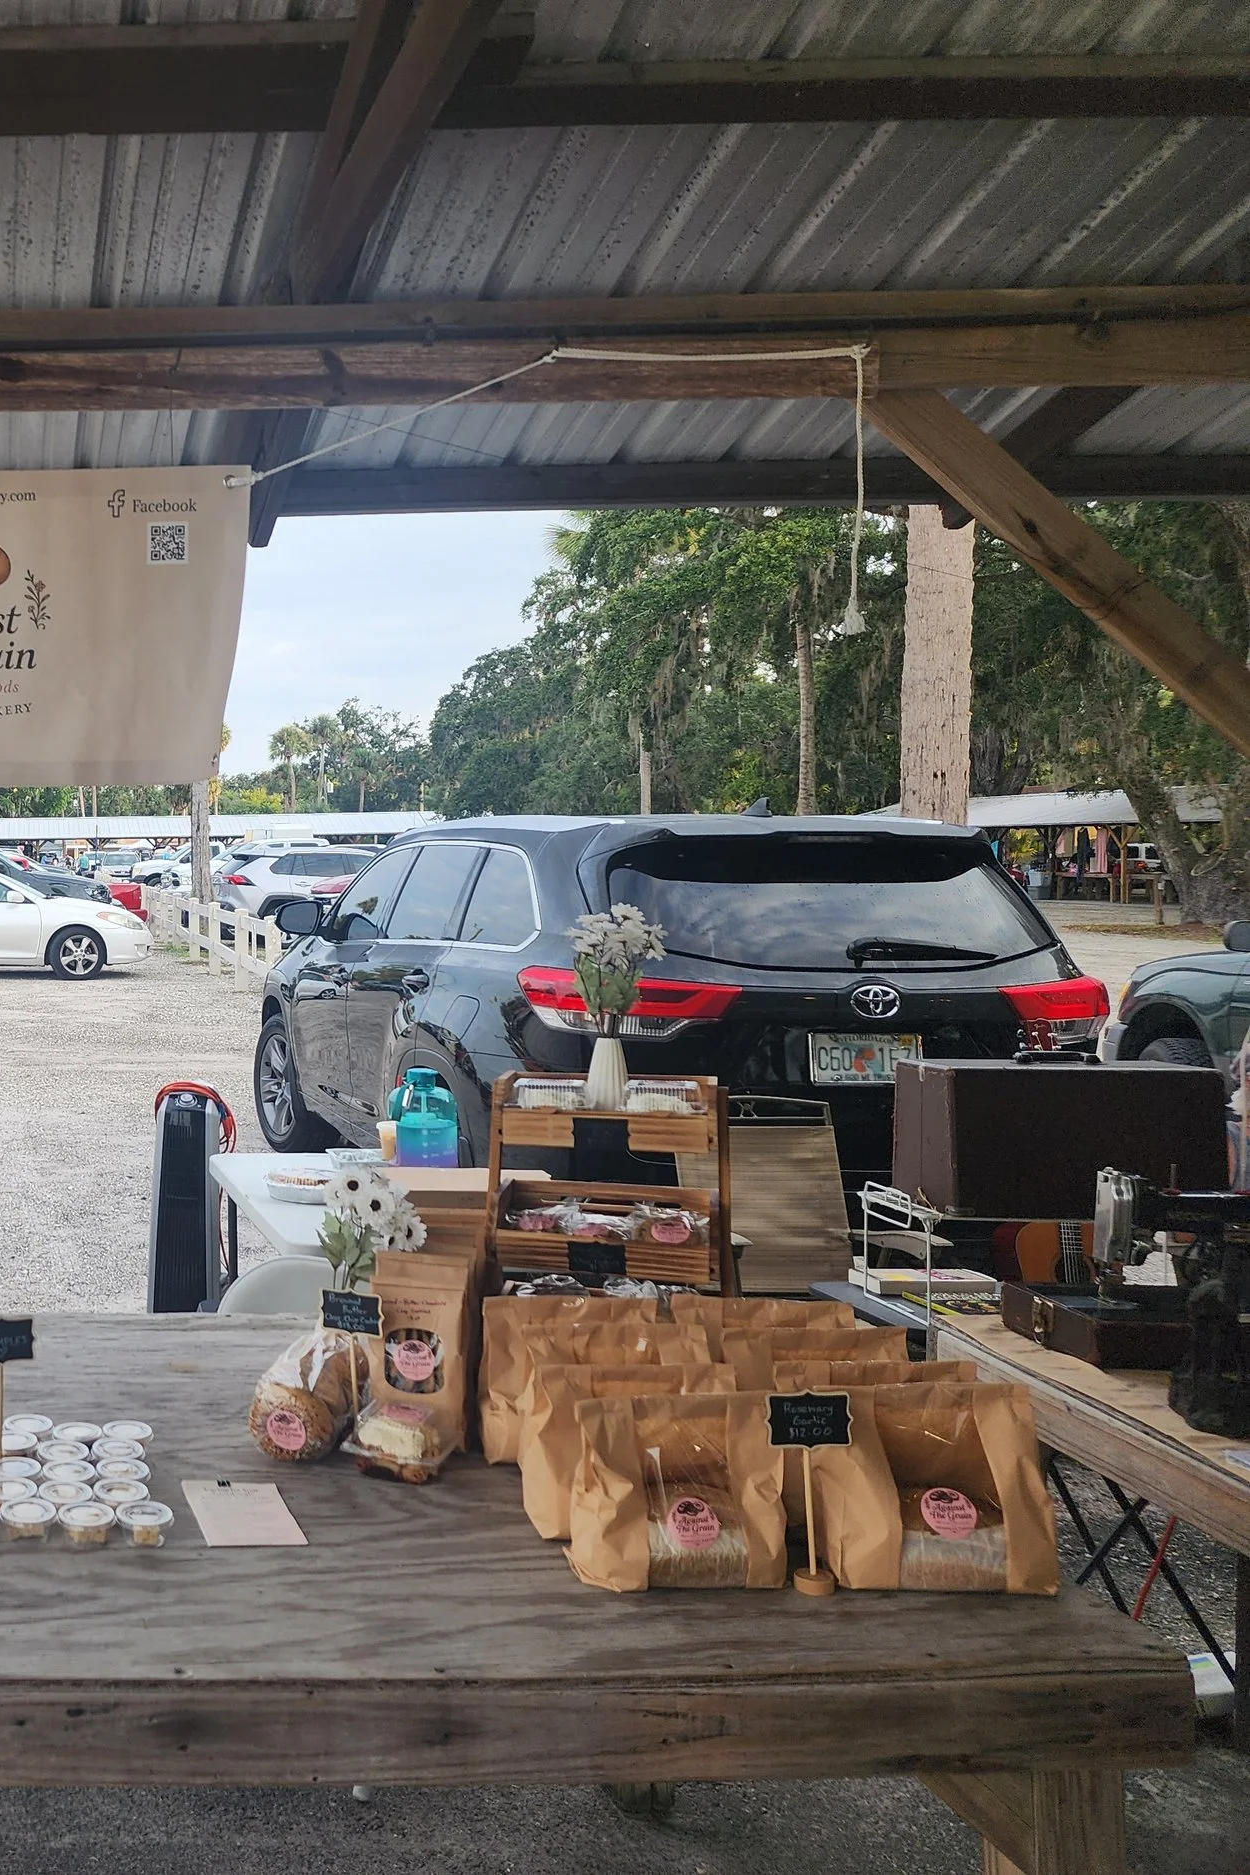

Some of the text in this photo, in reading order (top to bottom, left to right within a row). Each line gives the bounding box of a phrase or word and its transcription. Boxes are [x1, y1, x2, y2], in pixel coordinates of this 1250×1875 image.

[133, 498, 197, 513] Facebook
[782, 1402, 834, 1416] Rosemary
[792, 1415, 828, 1426] Garlic
[788, 1426, 833, 1439] $12.00
[932, 1502, 966, 1512] Against
[678, 1515, 709, 1526] Against
[930, 1510, 972, 1521] The Grain
[676, 1523, 715, 1535] The Grain
